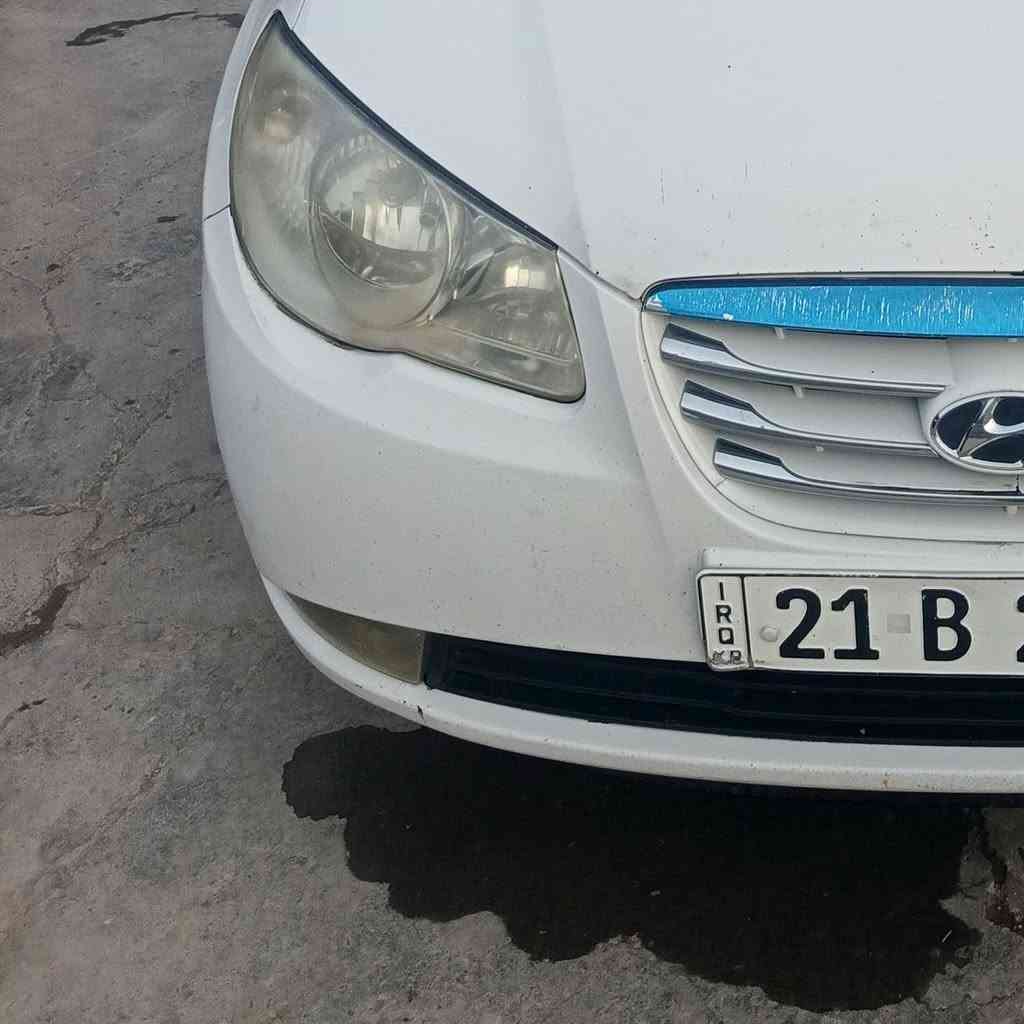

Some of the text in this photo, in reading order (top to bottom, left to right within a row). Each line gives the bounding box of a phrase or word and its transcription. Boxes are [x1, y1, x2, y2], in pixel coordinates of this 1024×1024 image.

[715, 582, 734, 644] IRQ
[776, 588, 880, 660] 21
[920, 589, 972, 662] B
